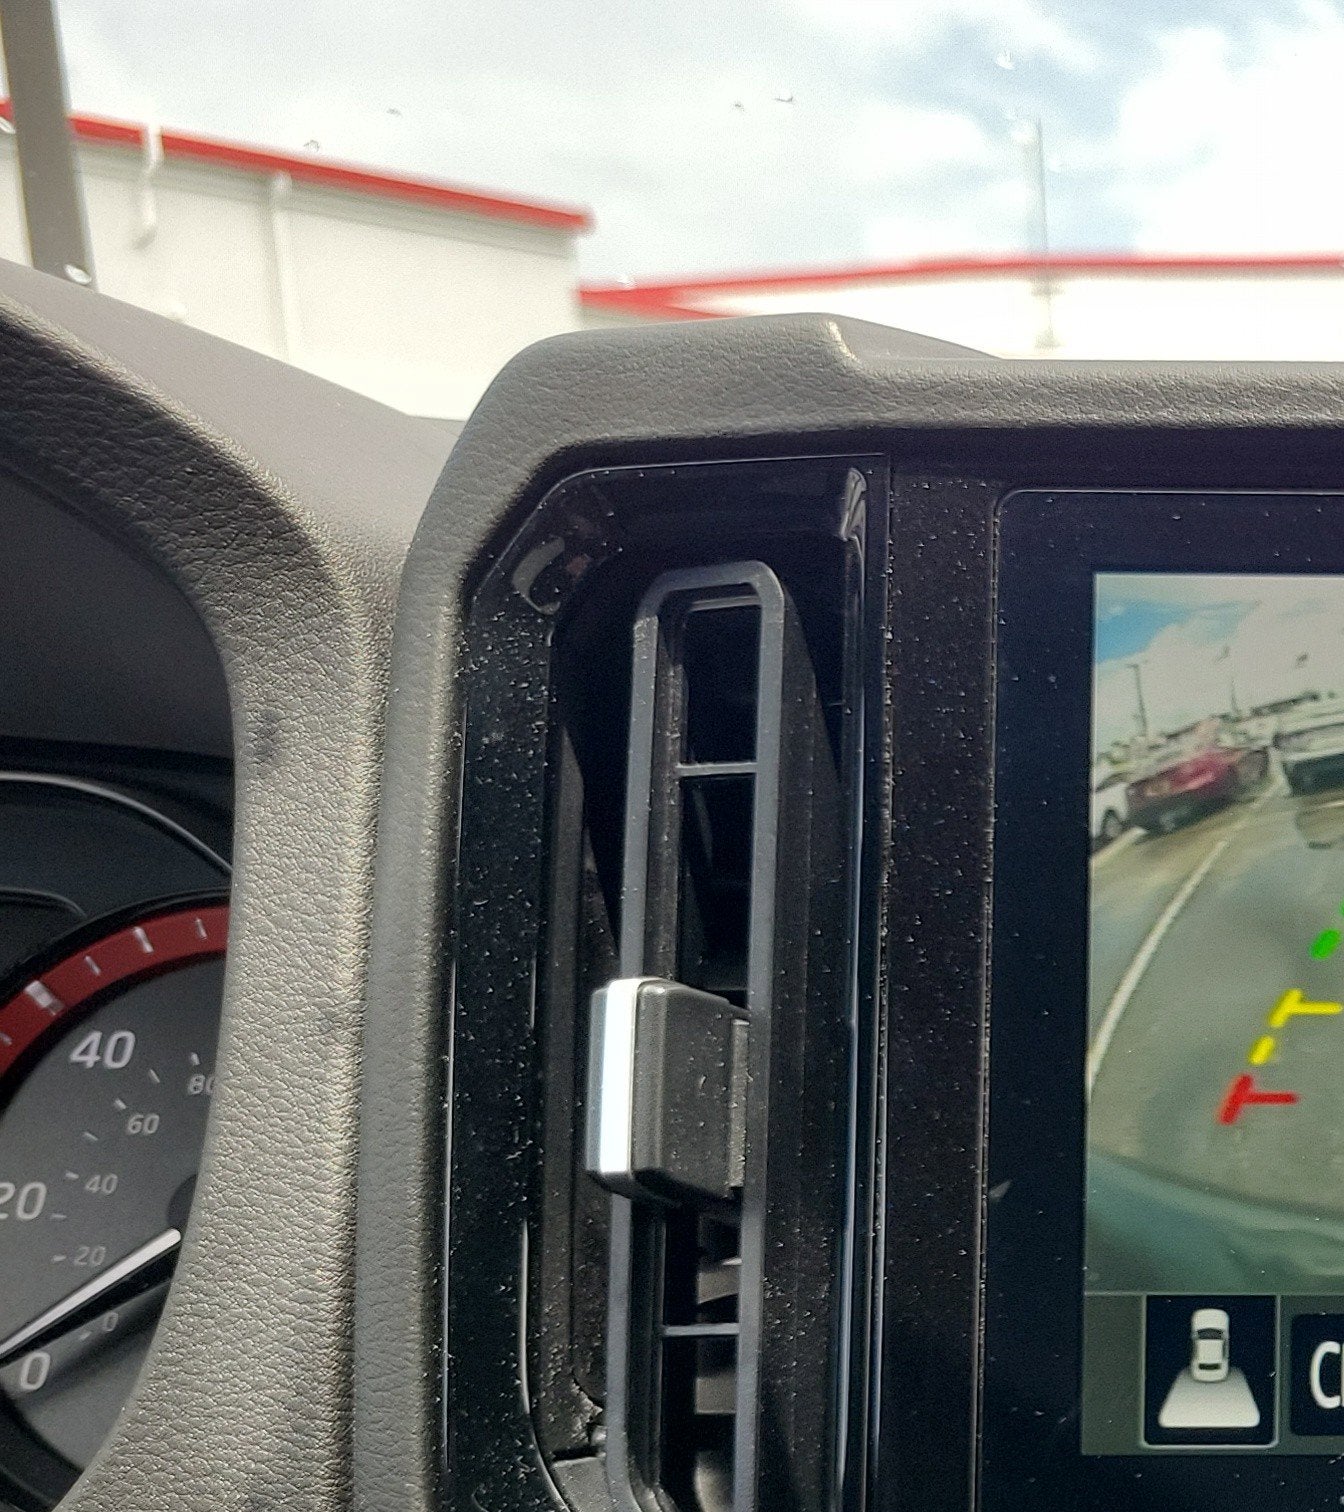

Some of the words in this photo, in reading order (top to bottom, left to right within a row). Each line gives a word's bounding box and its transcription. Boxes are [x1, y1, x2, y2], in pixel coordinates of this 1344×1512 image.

[70, 1030, 136, 1070] 40
[127, 1113, 160, 1135] 60
[85, 1173, 118, 1195] 40
[74, 1245, 106, 1267] 20
[104, 1311, 119, 1333] 0
[20, 1350, 51, 1391] 0
